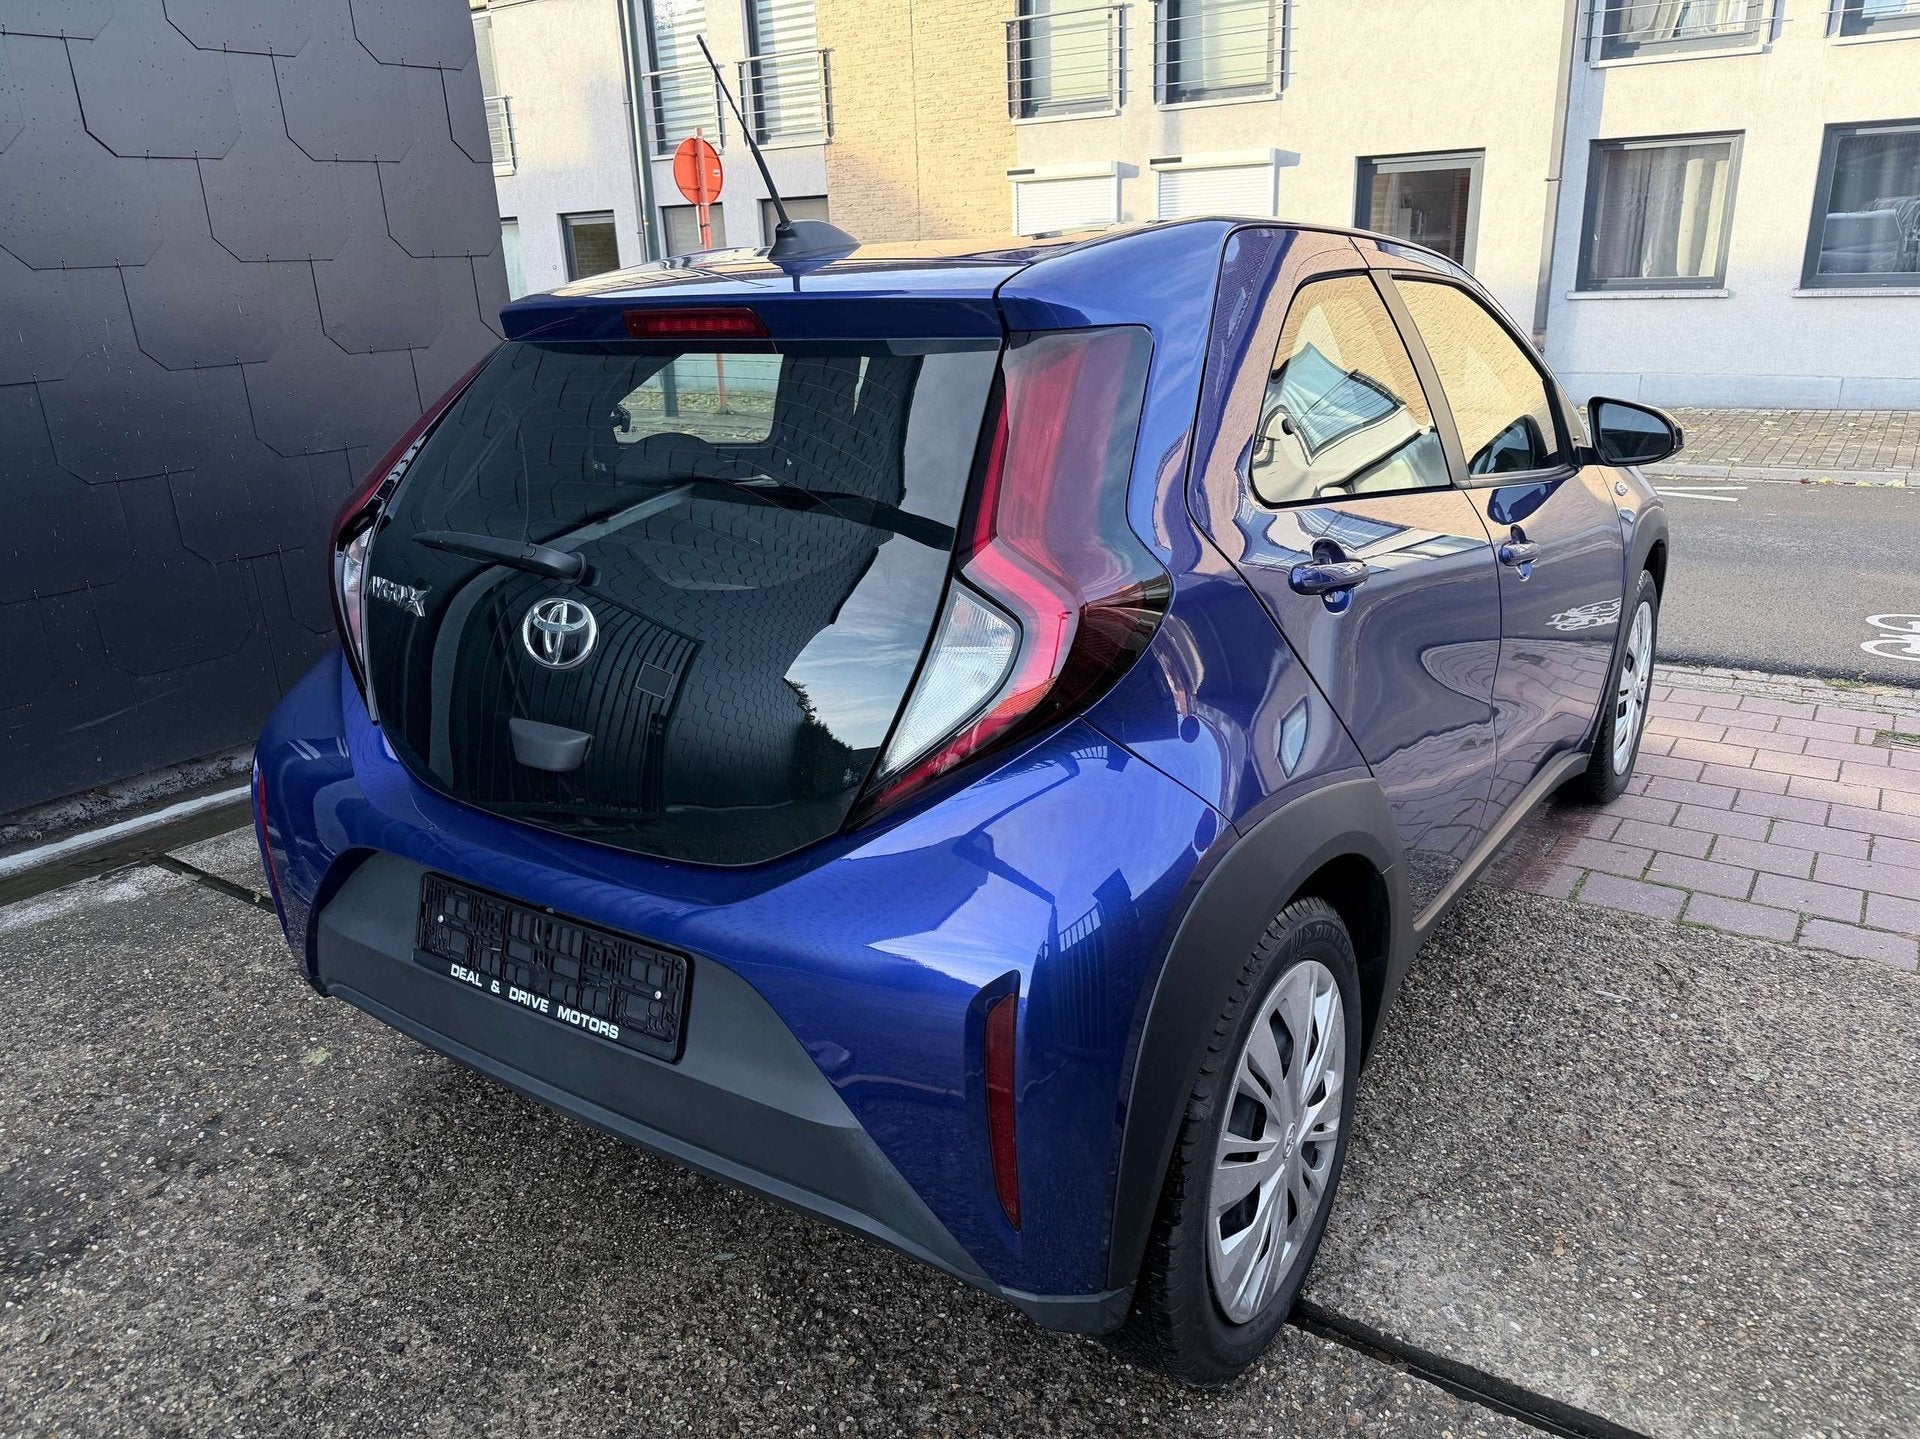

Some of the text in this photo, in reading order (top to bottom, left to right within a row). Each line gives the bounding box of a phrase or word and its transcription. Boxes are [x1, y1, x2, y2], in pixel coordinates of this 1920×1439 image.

[450, 963, 620, 1040] DEAL & DRIVE MOTORS
